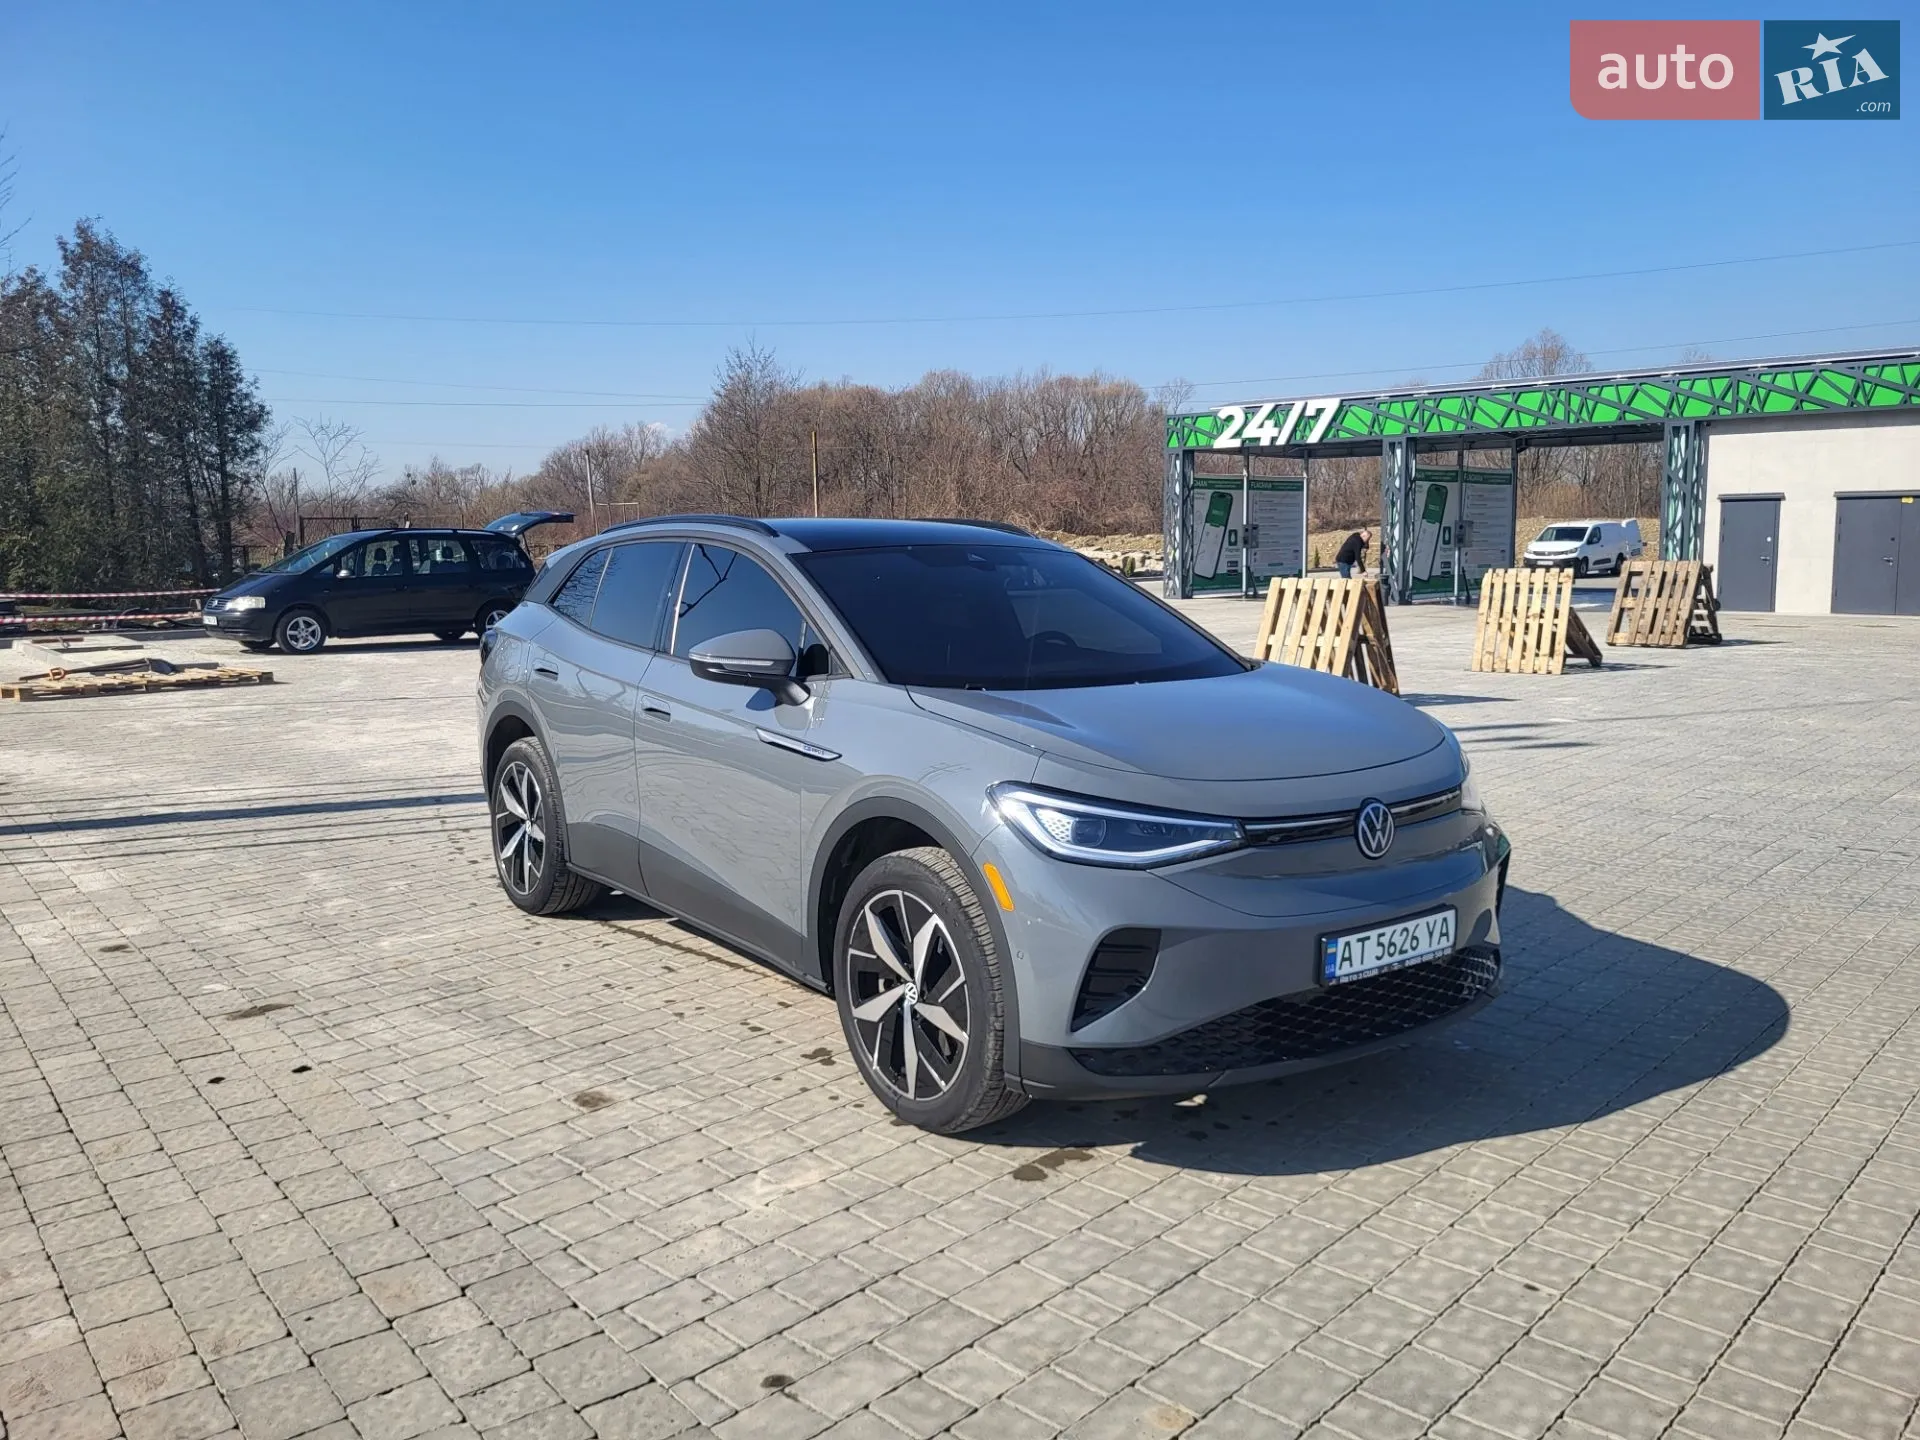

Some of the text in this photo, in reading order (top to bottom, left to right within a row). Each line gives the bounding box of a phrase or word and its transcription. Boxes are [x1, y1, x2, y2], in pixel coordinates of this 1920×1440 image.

[1213, 398, 1341, 449] 24/7
[1339, 936, 1371, 971] AT
[1375, 923, 1420, 961] 5626
[1426, 916, 1450, 948] YA
